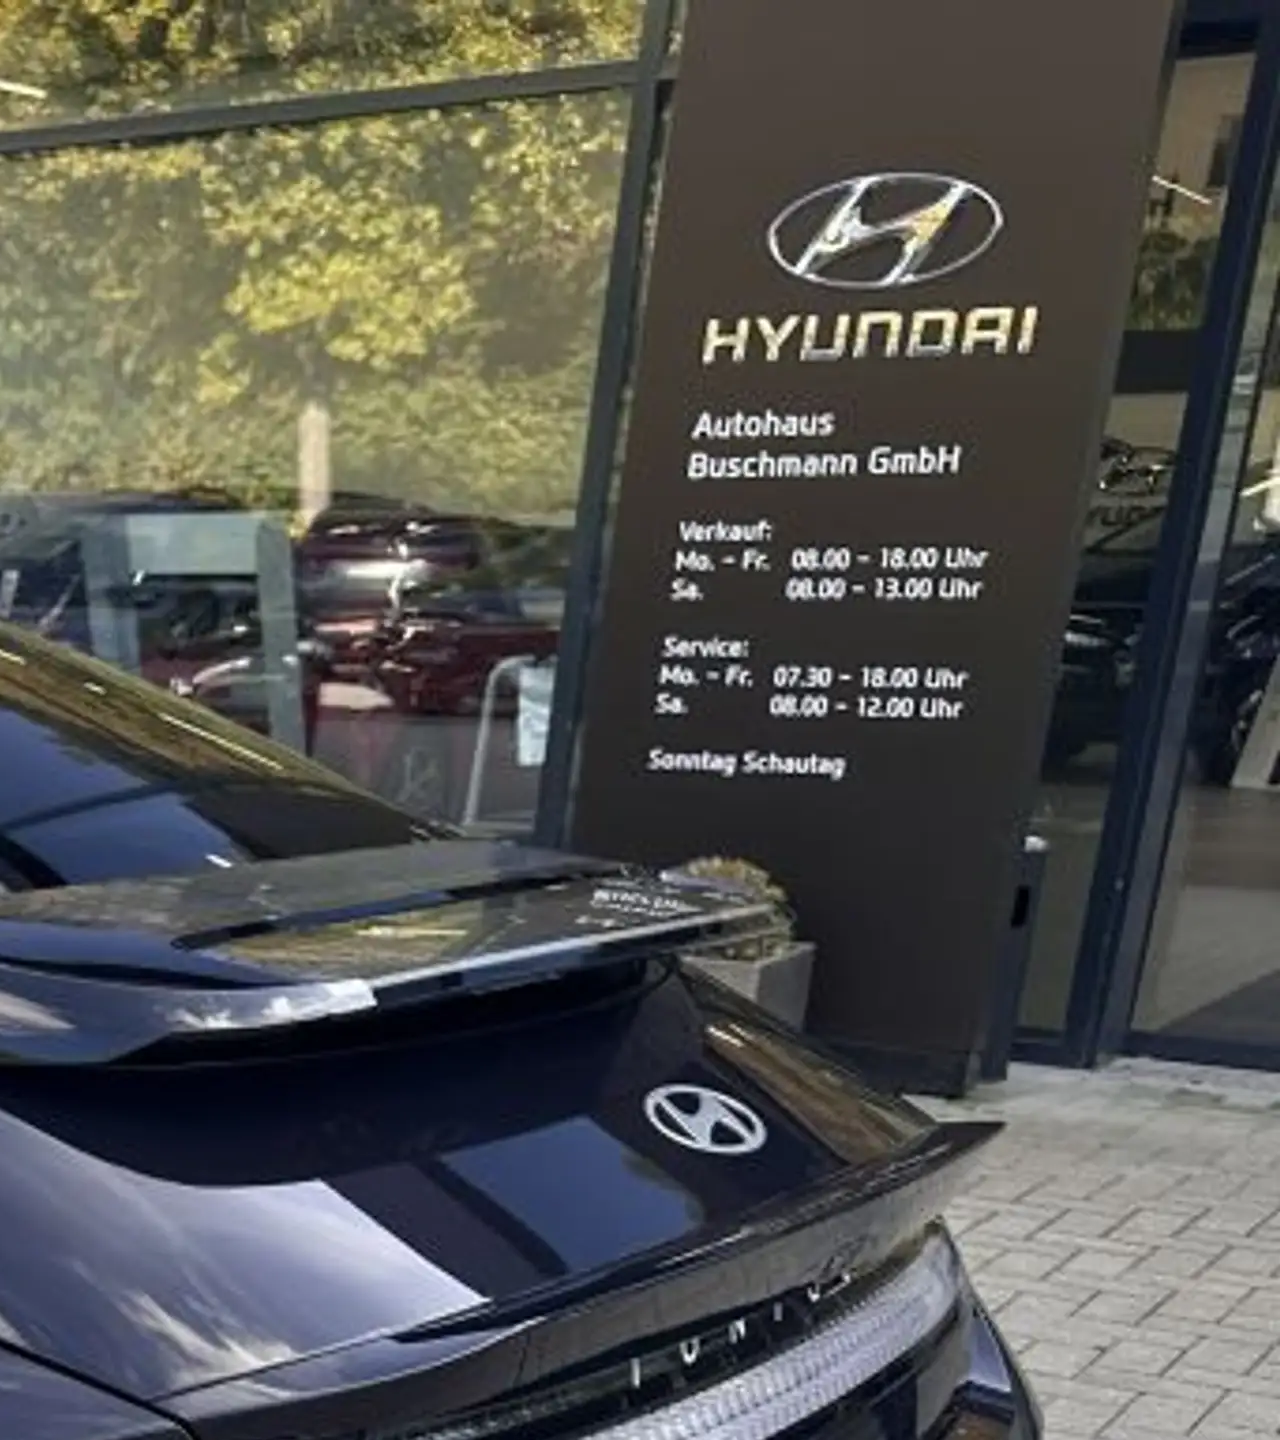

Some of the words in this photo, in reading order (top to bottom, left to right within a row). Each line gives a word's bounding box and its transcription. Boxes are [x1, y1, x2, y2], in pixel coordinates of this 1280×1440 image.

[702, 307, 1038, 364] HYUNDAI
[691, 411, 835, 439] Autohaus
[687, 450, 857, 480] Buschmann
[868, 447, 961, 474] GmbH
[679, 519, 772, 542] Verkauf:
[675, 550, 715, 571] Mo.
[742, 548, 771, 572] Fr.
[791, 547, 850, 570] 08.00
[881, 547, 939, 570] 18.00
[945, 547, 988, 568] Uhr
[670, 577, 704, 600] Sa.
[786, 576, 846, 600] 08.00
[875, 577, 933, 599] 13.00
[939, 578, 983, 599] Uhr
[662, 635, 749, 658] Service:
[659, 664, 699, 686] Mo.
[725, 665, 753, 687] Fr.
[773, 665, 832, 688] 07.30
[861, 666, 918, 688] 18.00
[924, 667, 969, 688] Uhr
[655, 692, 688, 714] Sa.
[769, 694, 828, 717] 08.00
[858, 696, 914, 718] 12.00
[920, 697, 963, 718] Uhr
[647, 748, 737, 777] Sonntag
[742, 751, 845, 780] Schautag
